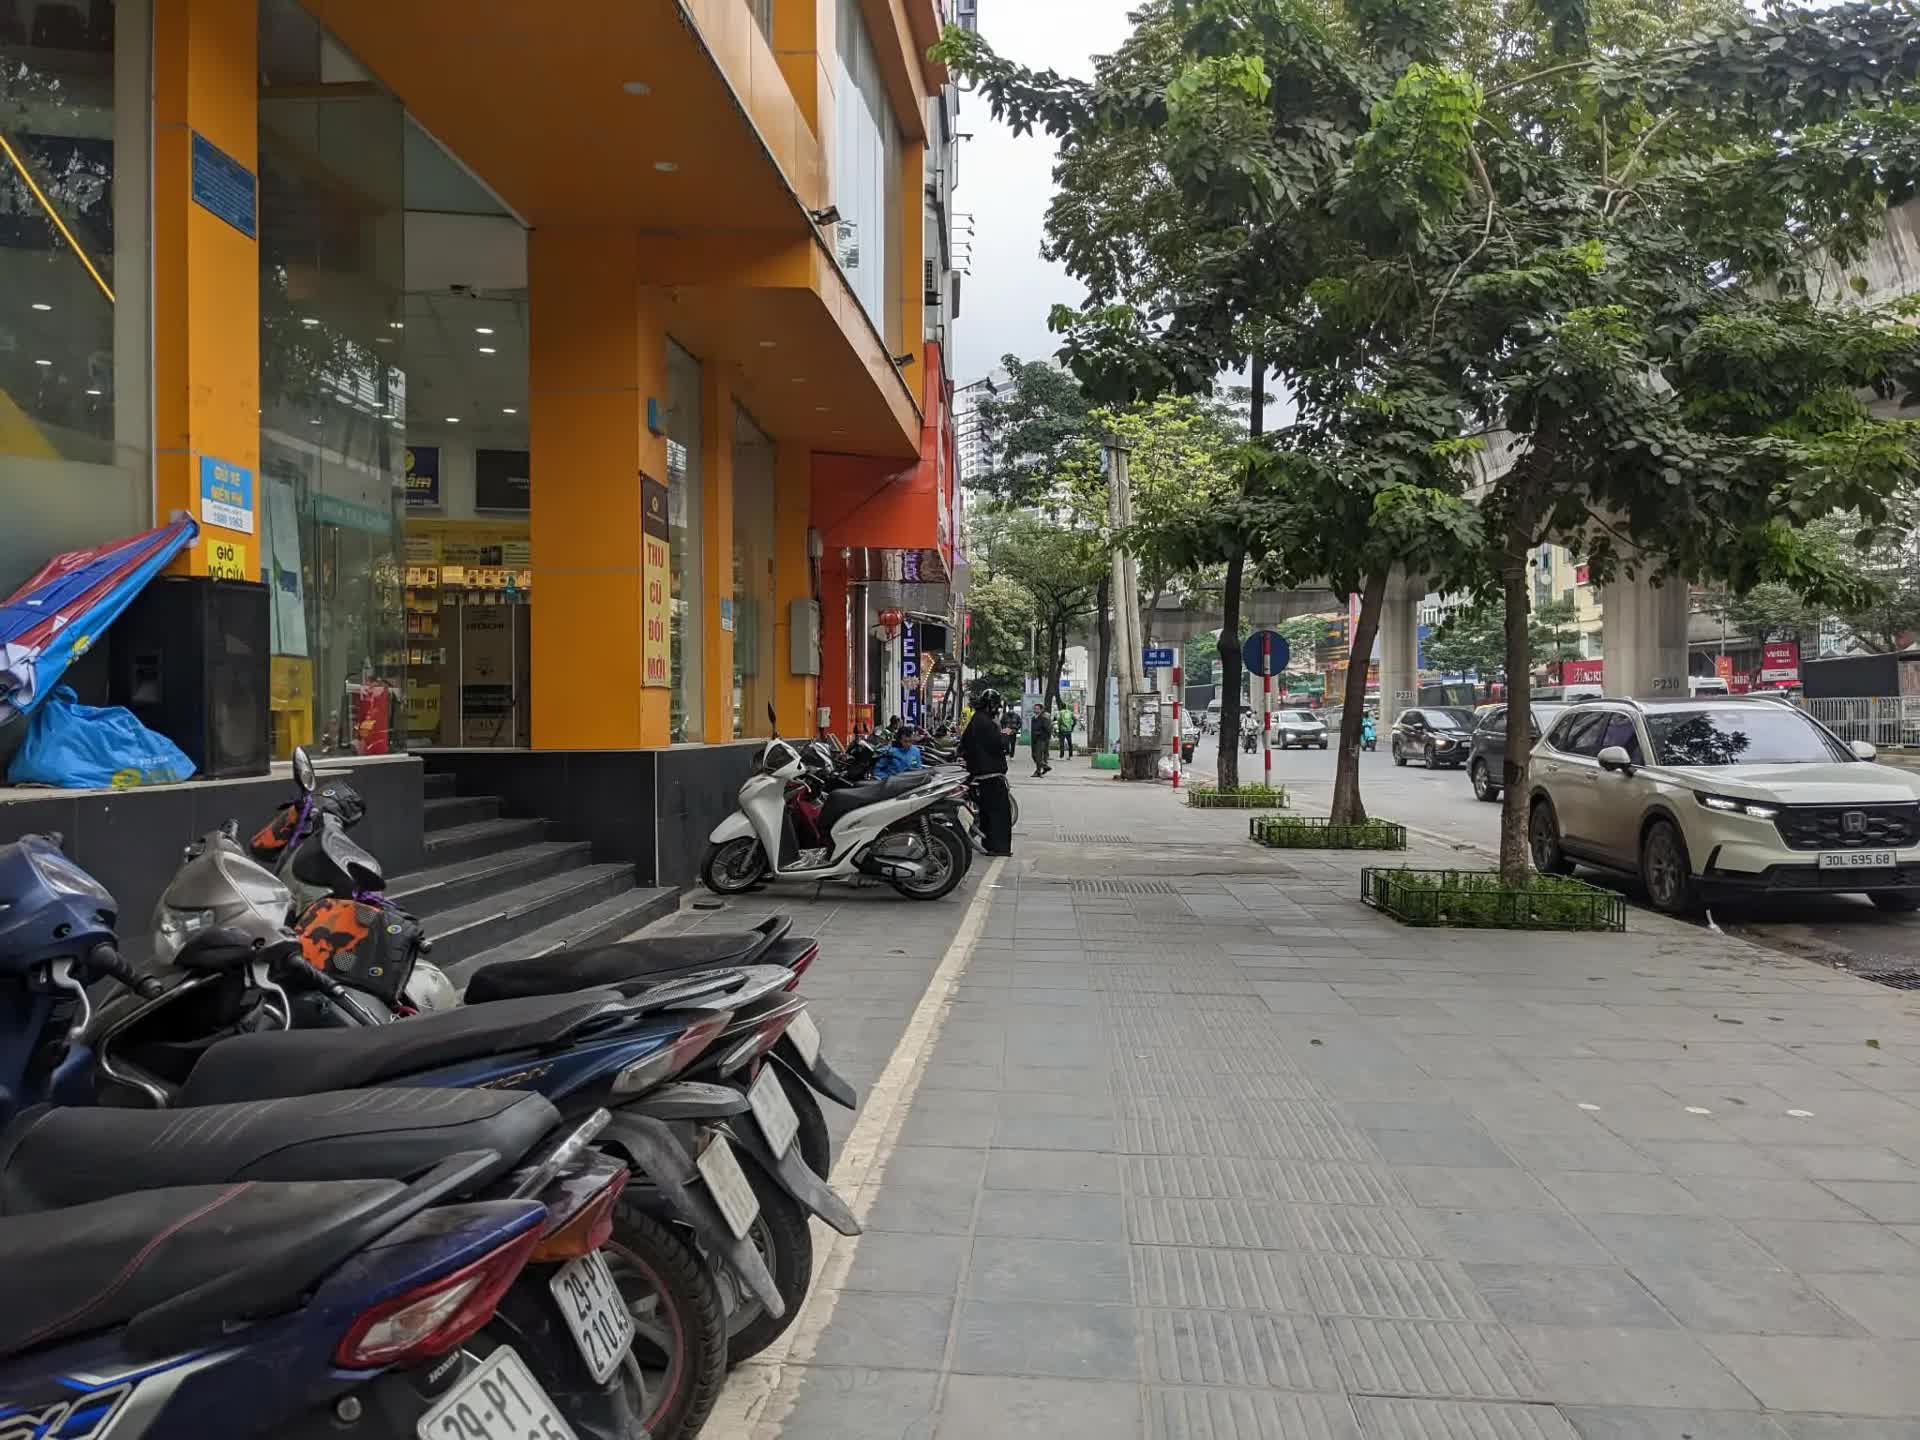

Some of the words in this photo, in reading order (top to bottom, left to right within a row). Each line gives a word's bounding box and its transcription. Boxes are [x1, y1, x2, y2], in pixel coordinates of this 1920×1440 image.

[216, 544, 234, 561] GIỜ
[647, 542, 664, 568] THU
[649, 579, 662, 605] CŨ
[1653, 679, 1680, 689] P230
[428, 1351, 461, 1384] HONDA
